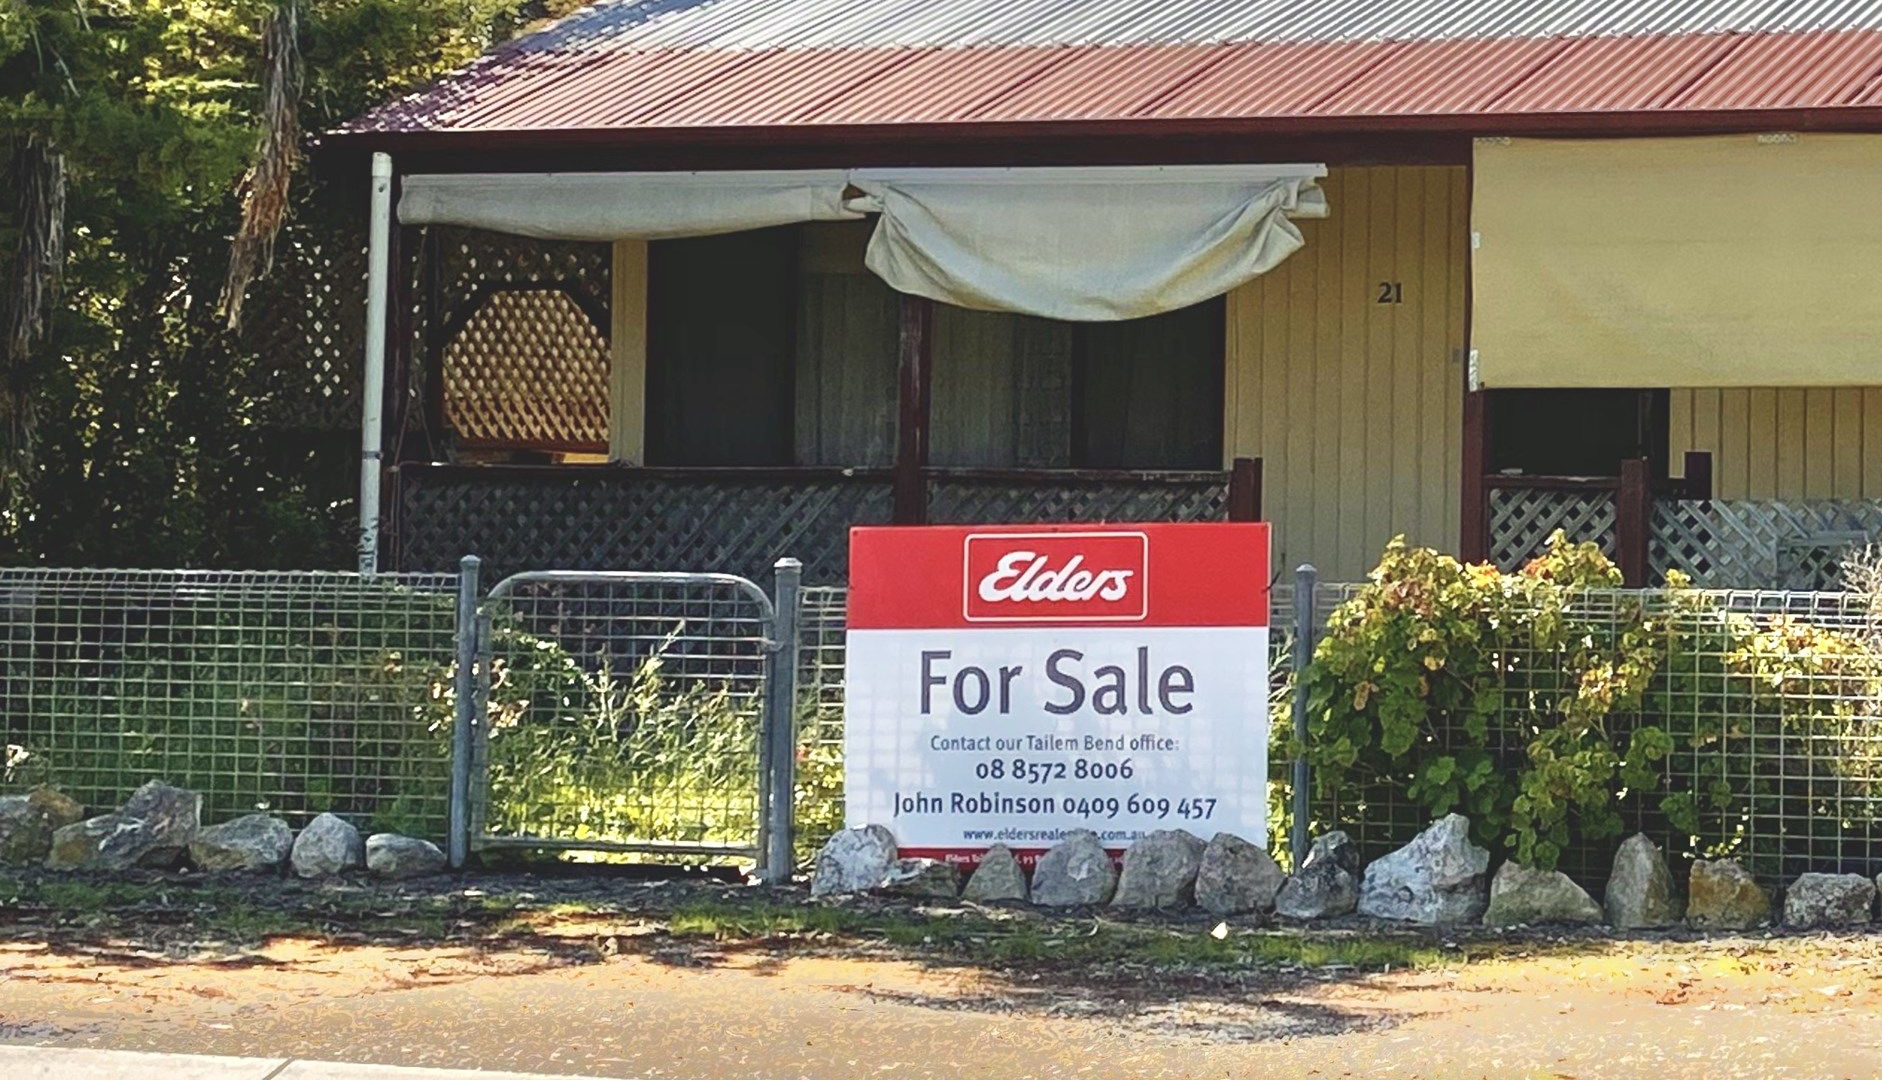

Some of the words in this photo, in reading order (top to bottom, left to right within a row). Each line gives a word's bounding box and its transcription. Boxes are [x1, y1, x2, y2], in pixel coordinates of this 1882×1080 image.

[1377, 282, 1402, 303] 21
[978, 551, 1134, 602] Elders
[920, 650, 1023, 716] For
[1044, 646, 1195, 716] Sale
[930, 735, 991, 751] Contact
[996, 739, 1022, 752] our
[1027, 734, 1079, 751] Tailem
[1084, 735, 1124, 751] Bend
[1129, 734, 1180, 751] office:
[975, 758, 1005, 780] 08
[1012, 758, 1067, 784] 8572
[1074, 758, 1134, 780] 8006
[894, 792, 943, 817] John
[951, 792, 1055, 814] Robinson
[1062, 797, 1119, 819] 0409
[1127, 793, 1170, 819] 609
[1177, 797, 1217, 820] 457
